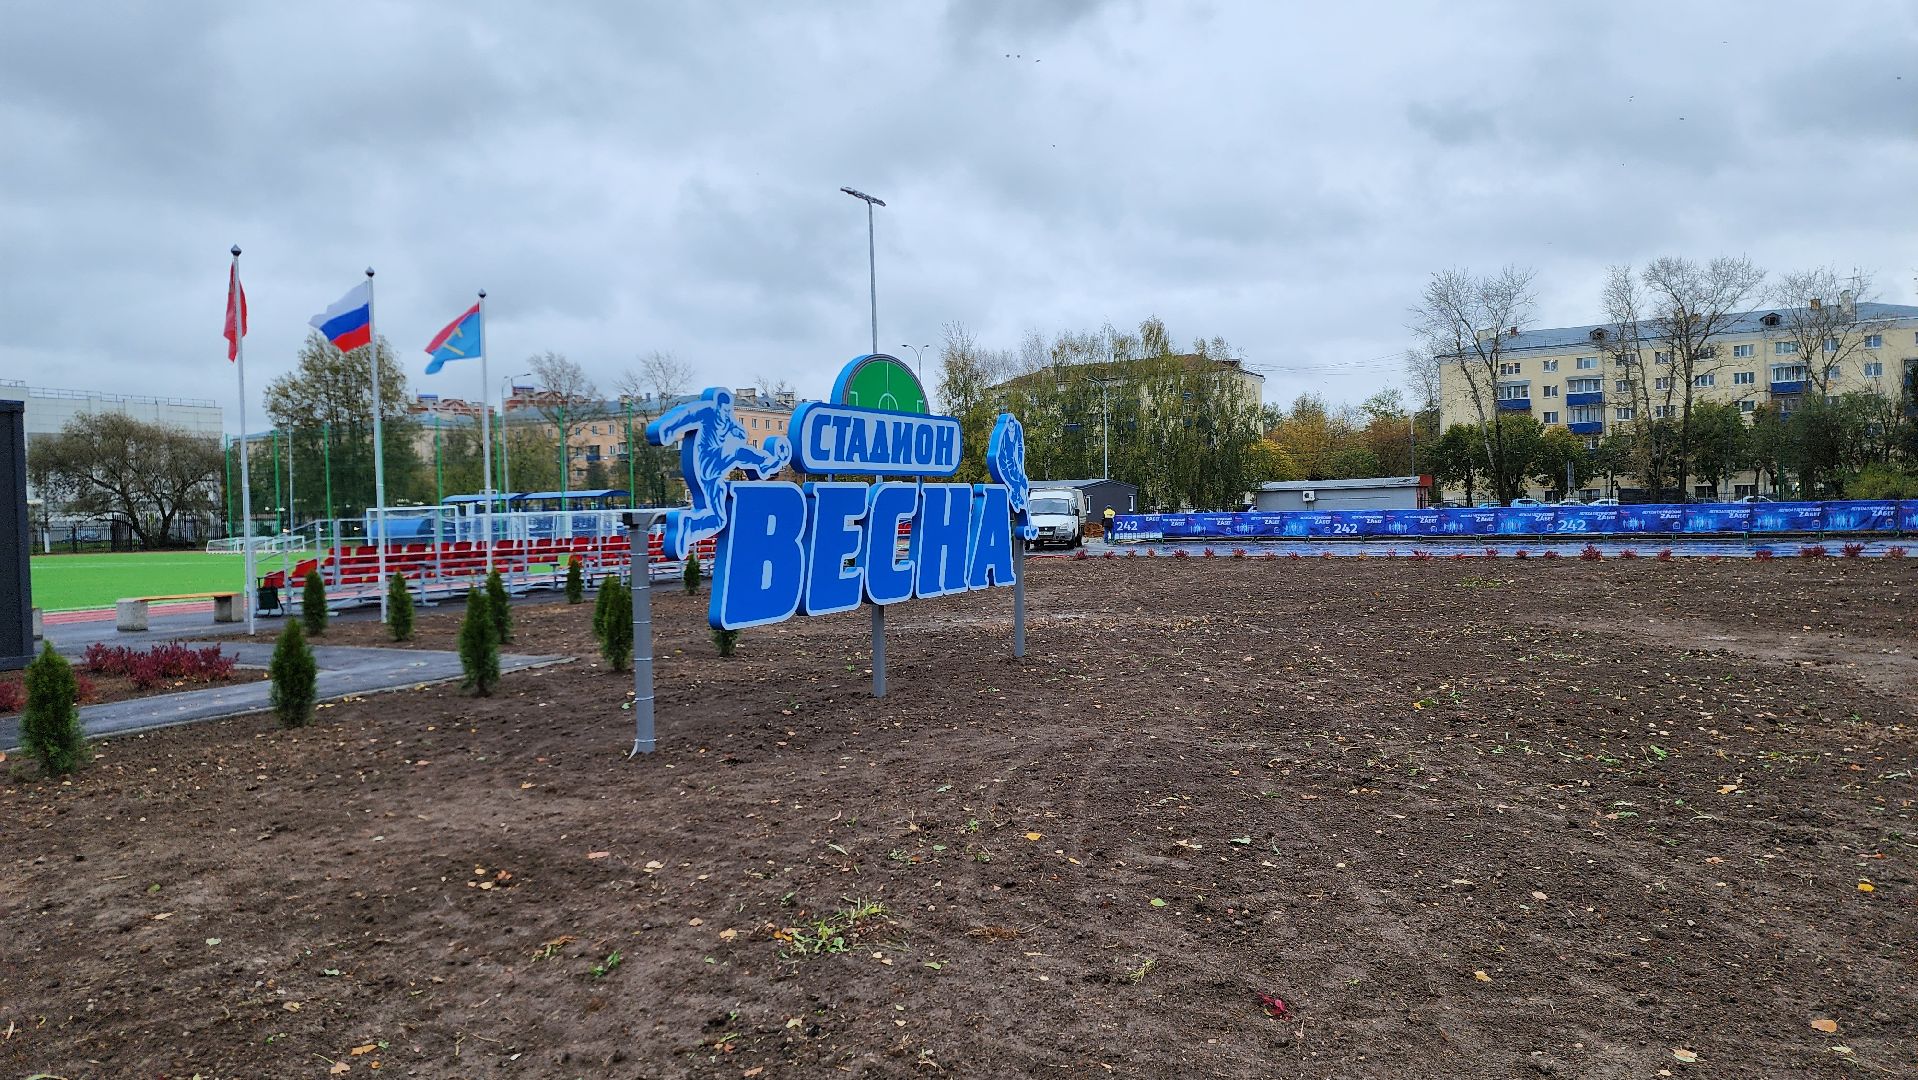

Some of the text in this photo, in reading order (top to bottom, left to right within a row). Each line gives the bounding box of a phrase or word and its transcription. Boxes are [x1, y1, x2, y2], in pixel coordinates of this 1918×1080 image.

[809, 414, 954, 467] СТАДИОН
[1116, 521, 1138, 531] 242
[1333, 523, 1357, 533] 242
[1557, 519, 1587, 531] 242
[720, 481, 1017, 630] ВЕСНА
